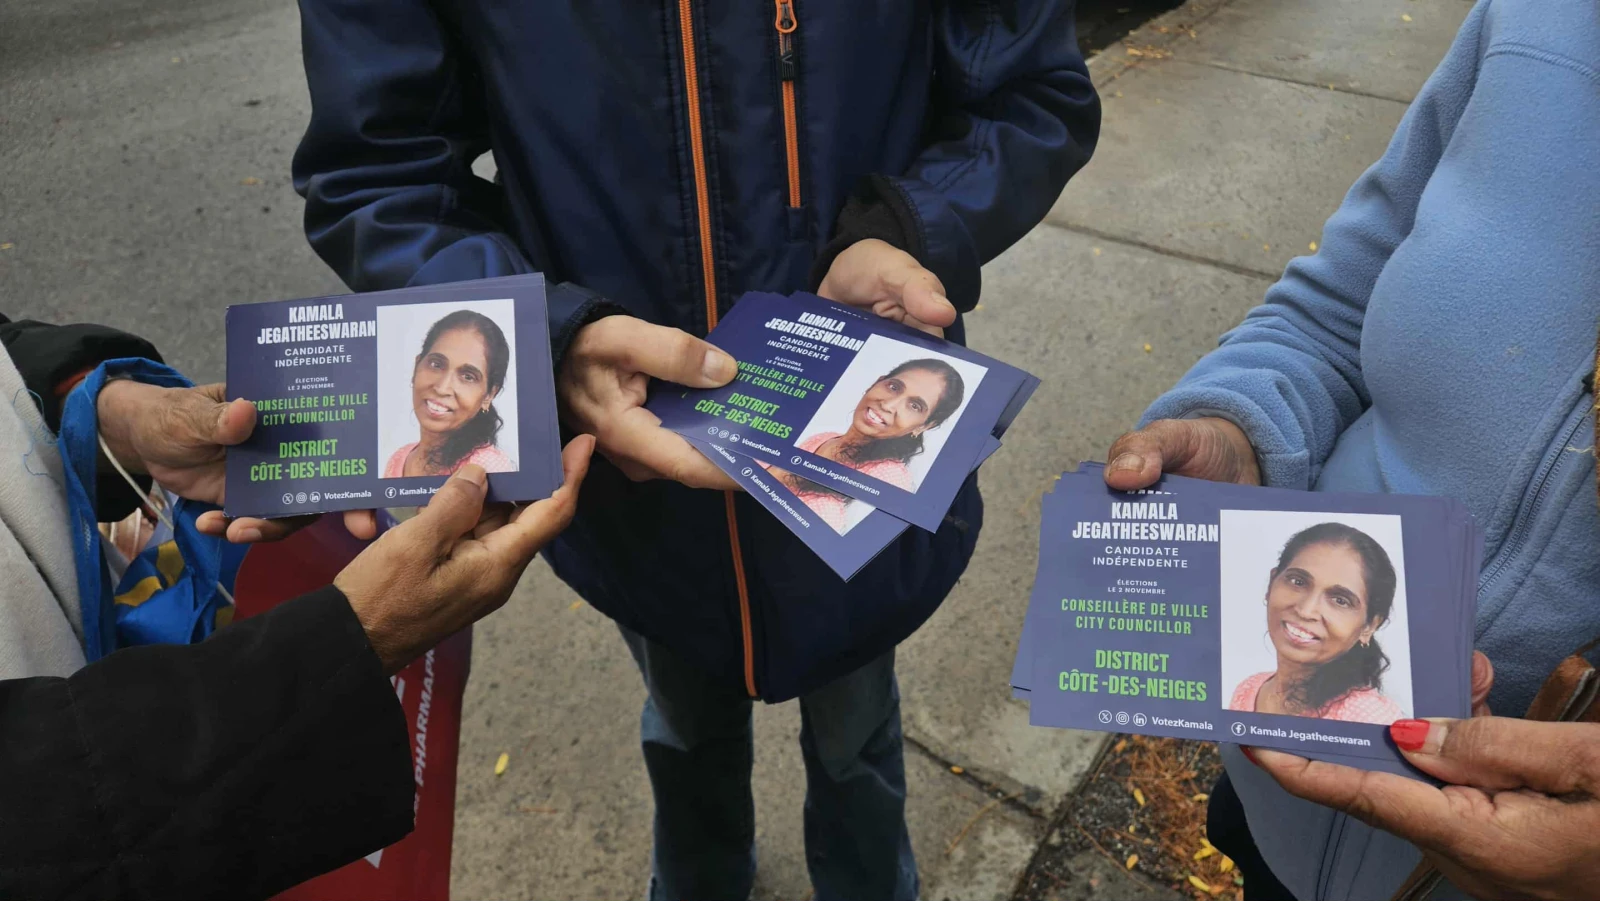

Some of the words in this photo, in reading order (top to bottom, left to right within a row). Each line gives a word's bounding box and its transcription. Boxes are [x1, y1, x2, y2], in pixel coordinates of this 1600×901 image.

[289, 304, 344, 323] KAMALA
[797, 311, 846, 333] KAMALA
[257, 320, 376, 344] JEGATHEESWARAN
[764, 317, 865, 352] JEGATHEESWARAN
[284, 344, 345, 356] CANDIDATE
[766, 339, 831, 362] INDÉPENDENTE
[779, 335, 830, 353] CANDIDATE
[275, 355, 352, 368] INDÉPENDENTE
[777, 361, 804, 373] NOVEMBRE
[295, 376, 328, 384] ÉLECTIONS
[736, 372, 753, 383] ITY
[751, 376, 808, 399] COUNCILLOR
[786, 375, 798, 385] DE
[798, 378, 825, 393] VILLE
[322, 395, 335, 407] DE
[339, 393, 368, 405] VILLE
[694, 399, 726, 417] CÔTE
[727, 392, 780, 417] DISTRICT
[263, 413, 286, 426] CITY
[289, 409, 355, 425] COUNCILLOR
[279, 438, 338, 459] DISTRICT
[741, 438, 781, 457] VotezKamala
[250, 460, 282, 482] CÔTE
[802, 460, 827, 475] Kamala
[826, 467, 881, 496] Jegatheeswaran
[324, 490, 372, 500] VotezKamala
[399, 487, 427, 496] Kamala
[750, 474, 771, 494] Kamala
[768, 490, 811, 529] Jegatheeswaran
[1111, 502, 1178, 520] KAMALA
[1072, 521, 1219, 542] JEGATHEESWARAN
[1105, 545, 1179, 557] CANDIDATE
[1093, 556, 1188, 569] INDÉPENDENTE
[1117, 578, 1158, 587] ÉLECTIONS
[1125, 587, 1166, 595] NOVEMBRE
[1061, 598, 1146, 615] CONSEILLÈRE
[1150, 602, 1166, 616] DE
[1171, 603, 1209, 618] VILLE
[1075, 616, 1105, 629] CITY
[1109, 617, 1192, 635] COUNCILLOR
[1095, 649, 1170, 673] DISTRICT
[1059, 668, 1099, 693] CÔTE
[1151, 716, 1213, 731] VotezKamala
[1250, 726, 1287, 739] Kamala
[1288, 729, 1371, 747] Jegatheeswaran
